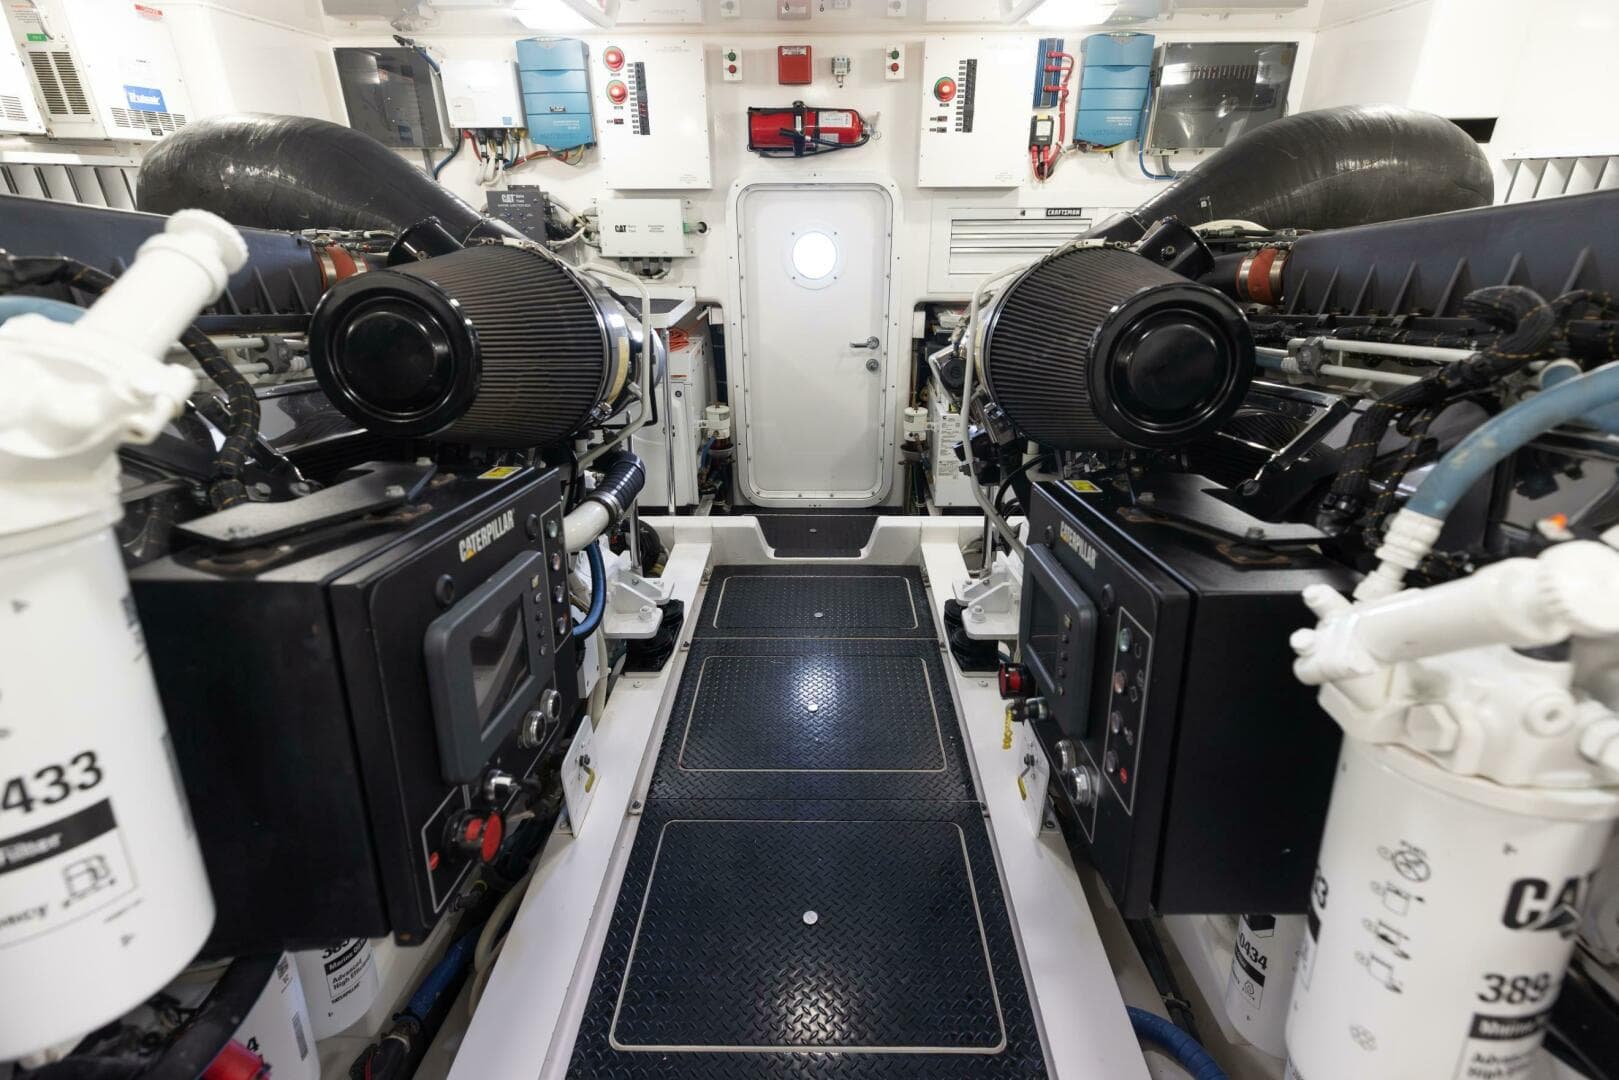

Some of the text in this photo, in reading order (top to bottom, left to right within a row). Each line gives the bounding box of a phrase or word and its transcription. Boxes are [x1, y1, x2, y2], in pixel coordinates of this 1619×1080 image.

[501, 194, 516, 203] CAT
[1047, 209, 1081, 217] CRAFTSMAN
[615, 224, 627, 233] CAT
[458, 509, 515, 563] CATERPILLAR
[1059, 520, 1098, 570] CATERPILLAR
[329, 950, 355, 971] Marine
